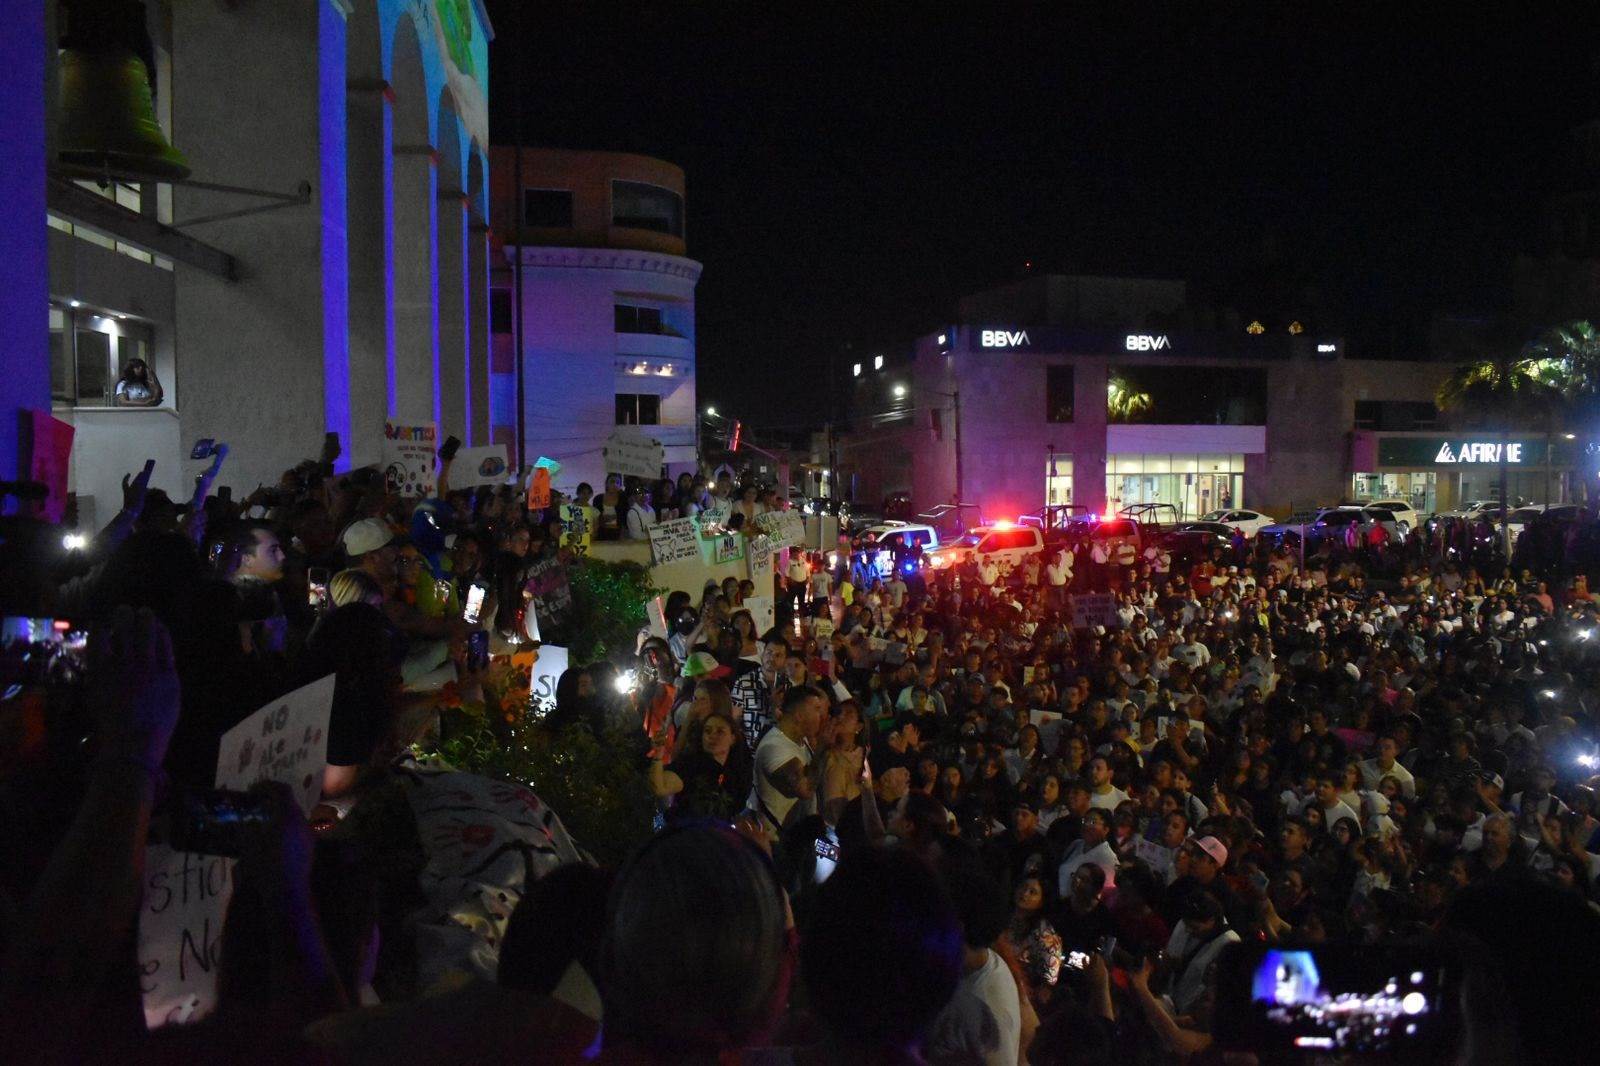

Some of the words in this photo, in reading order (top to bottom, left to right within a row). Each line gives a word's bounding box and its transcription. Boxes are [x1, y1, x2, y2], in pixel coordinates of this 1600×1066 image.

[982, 330, 1031, 347] BBVA
[1127, 335, 1171, 351] BBVA
[724, 537, 735, 548] NO
